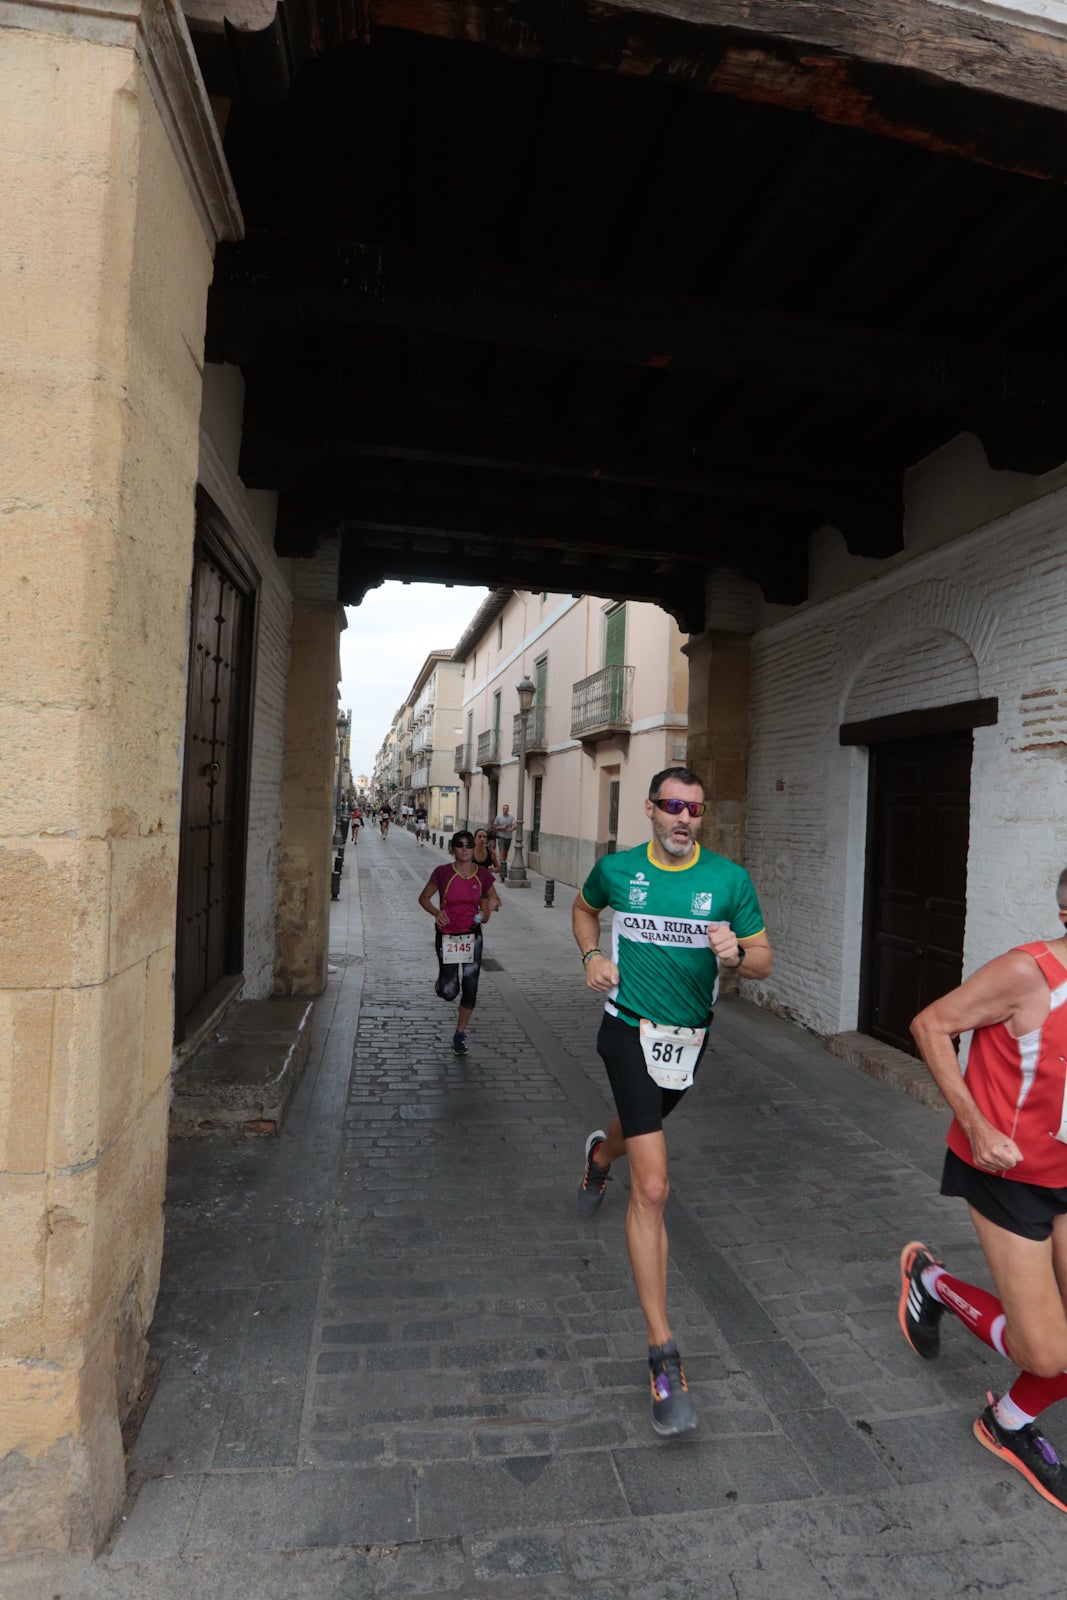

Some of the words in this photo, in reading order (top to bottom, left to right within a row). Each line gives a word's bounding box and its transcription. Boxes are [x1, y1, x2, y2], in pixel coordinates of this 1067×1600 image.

[623, 917, 658, 930] CAJA
[641, 932, 693, 944] GRANADA
[447, 943, 471, 952] 2145
[652, 1042, 684, 1064] 581
